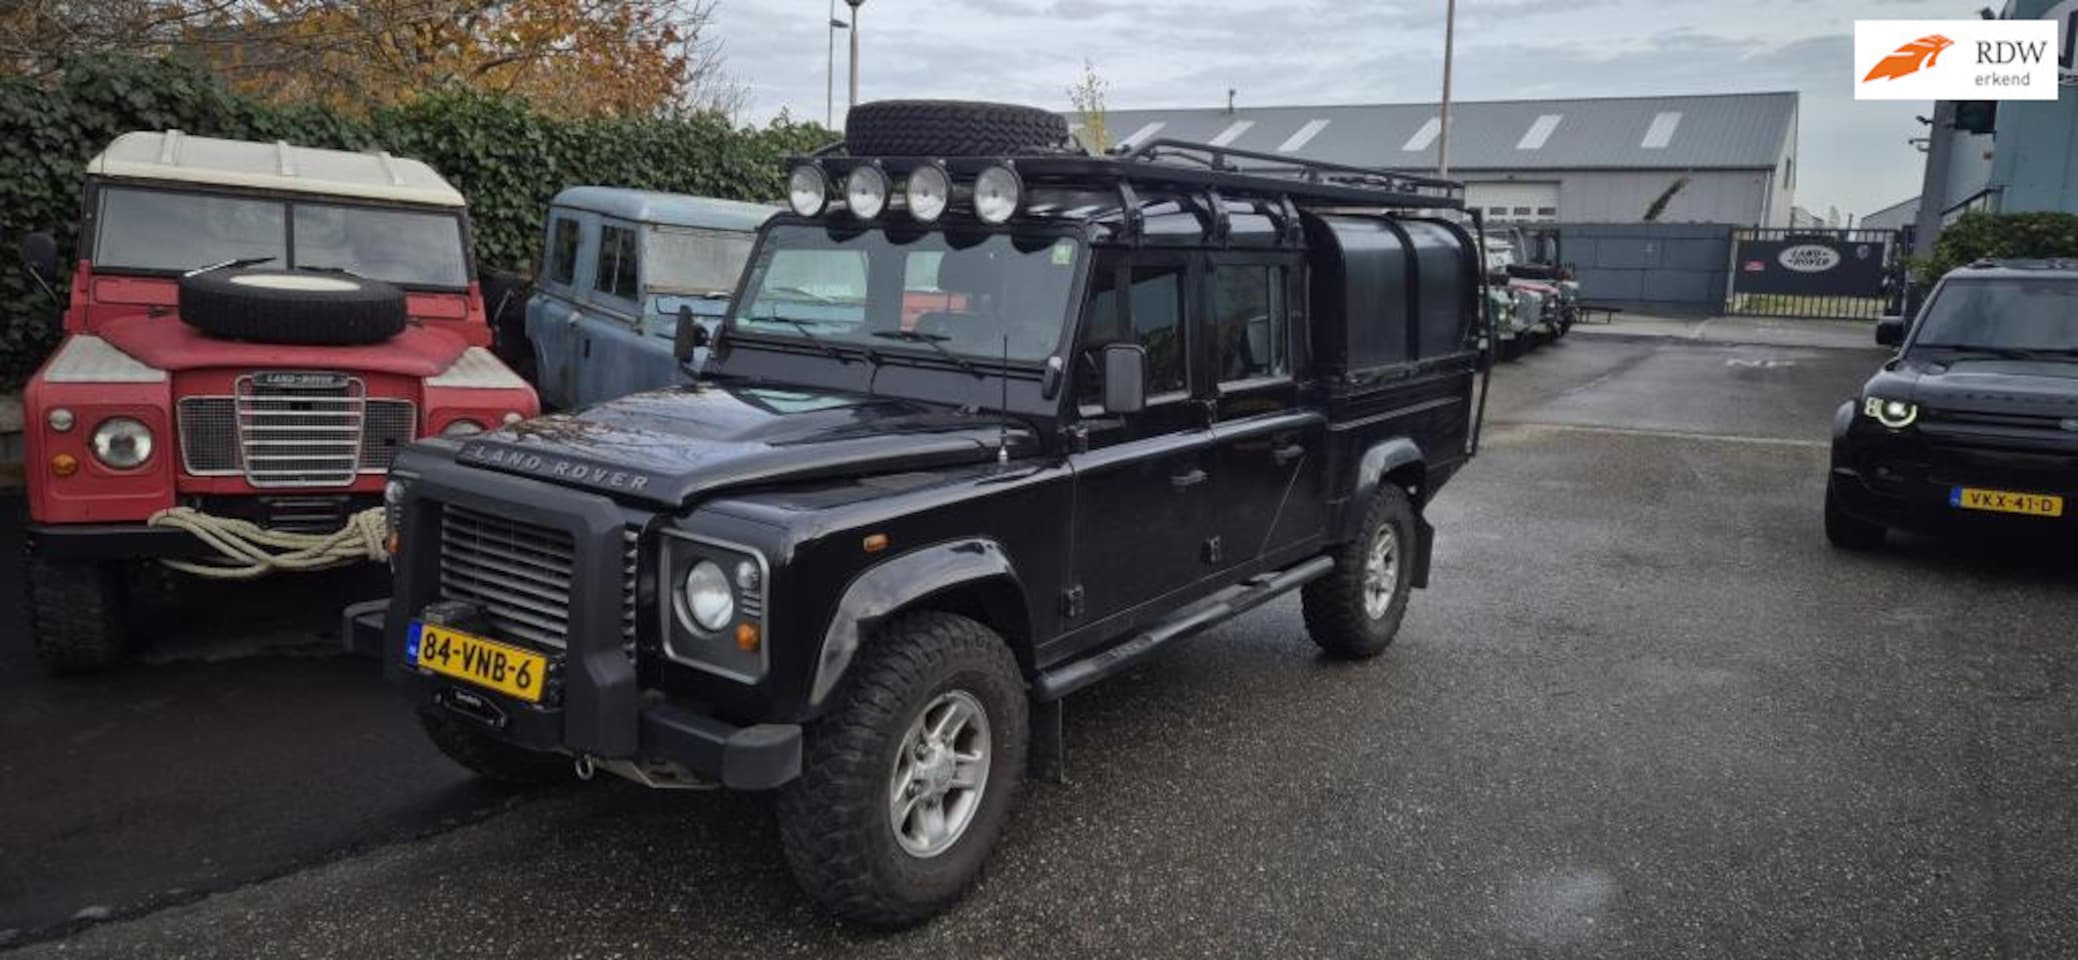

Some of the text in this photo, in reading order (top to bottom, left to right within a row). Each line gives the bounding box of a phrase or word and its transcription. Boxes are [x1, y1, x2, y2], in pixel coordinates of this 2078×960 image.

[475, 445, 649, 491] LAND ROVER
[1970, 492, 2053, 512] VKX-41-D
[424, 632, 532, 689] 84-VNB-6
